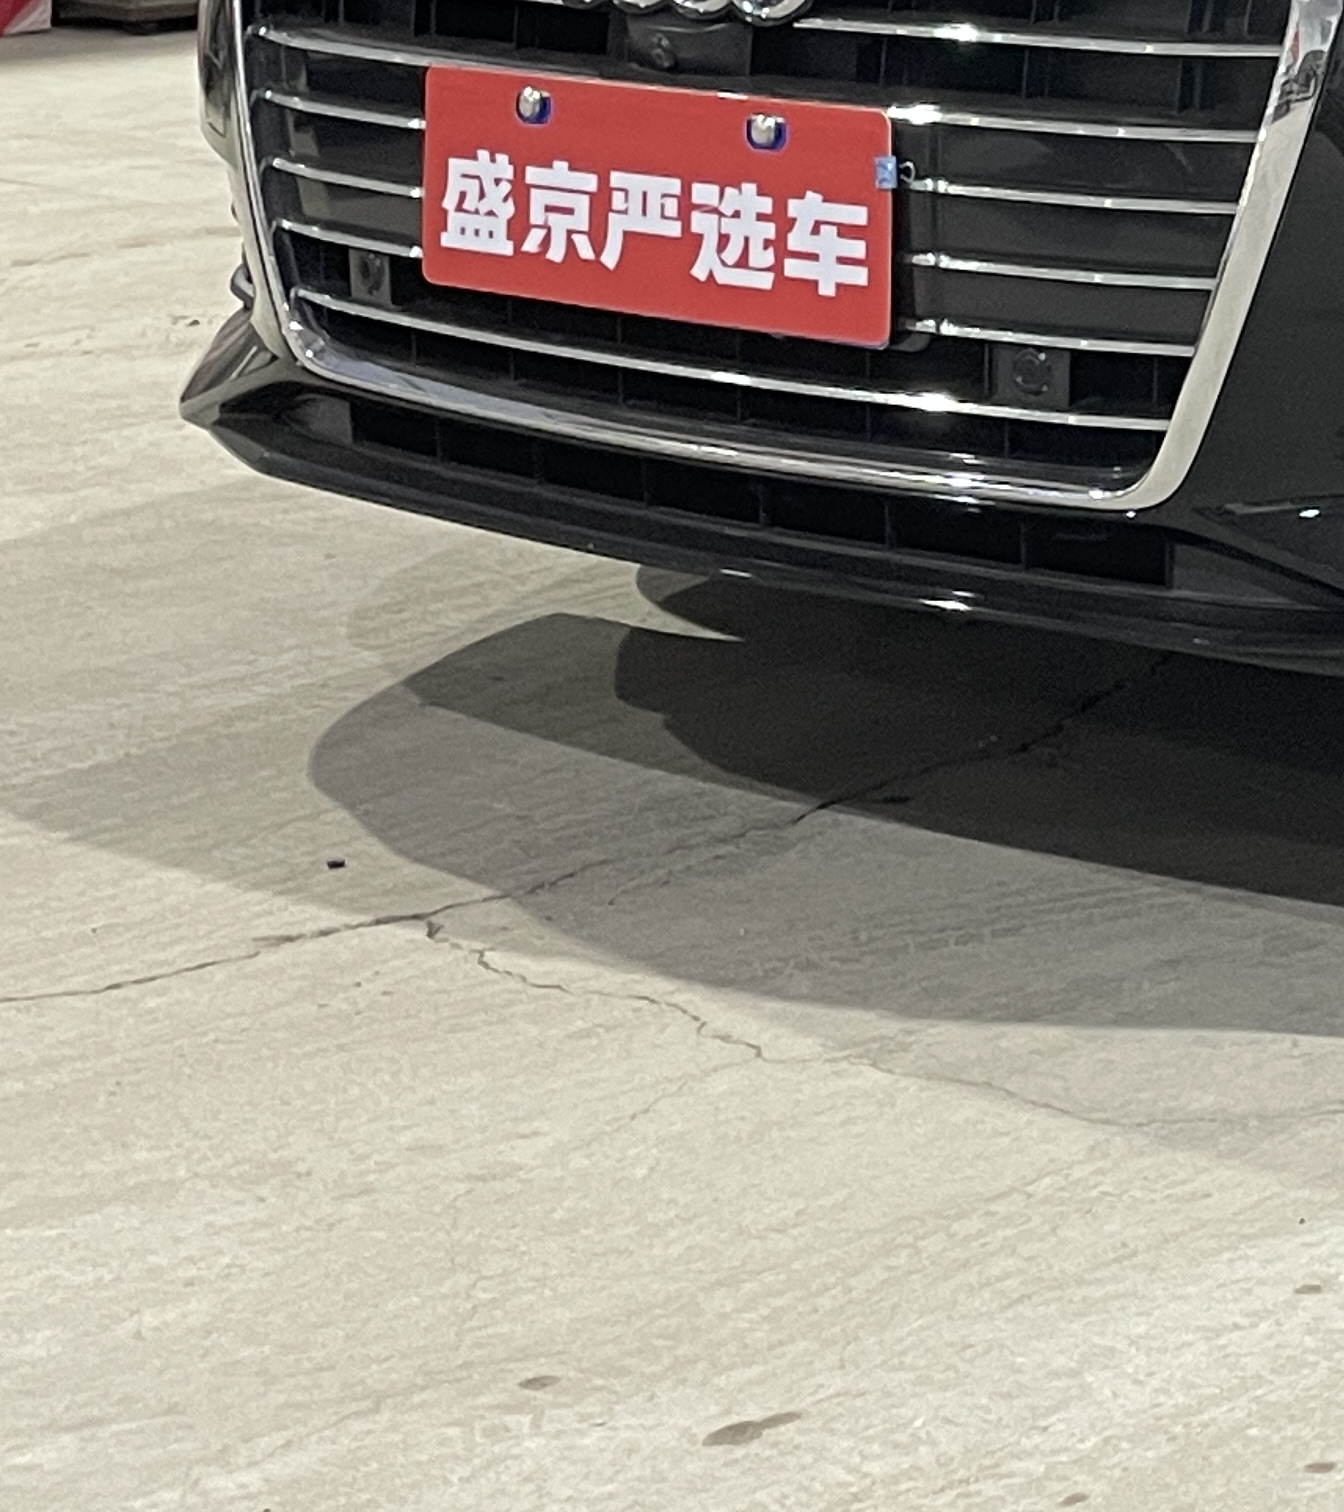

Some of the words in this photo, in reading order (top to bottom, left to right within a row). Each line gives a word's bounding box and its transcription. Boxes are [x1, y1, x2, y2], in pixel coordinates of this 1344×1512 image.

[440, 148, 869, 297] 盛京严选车
